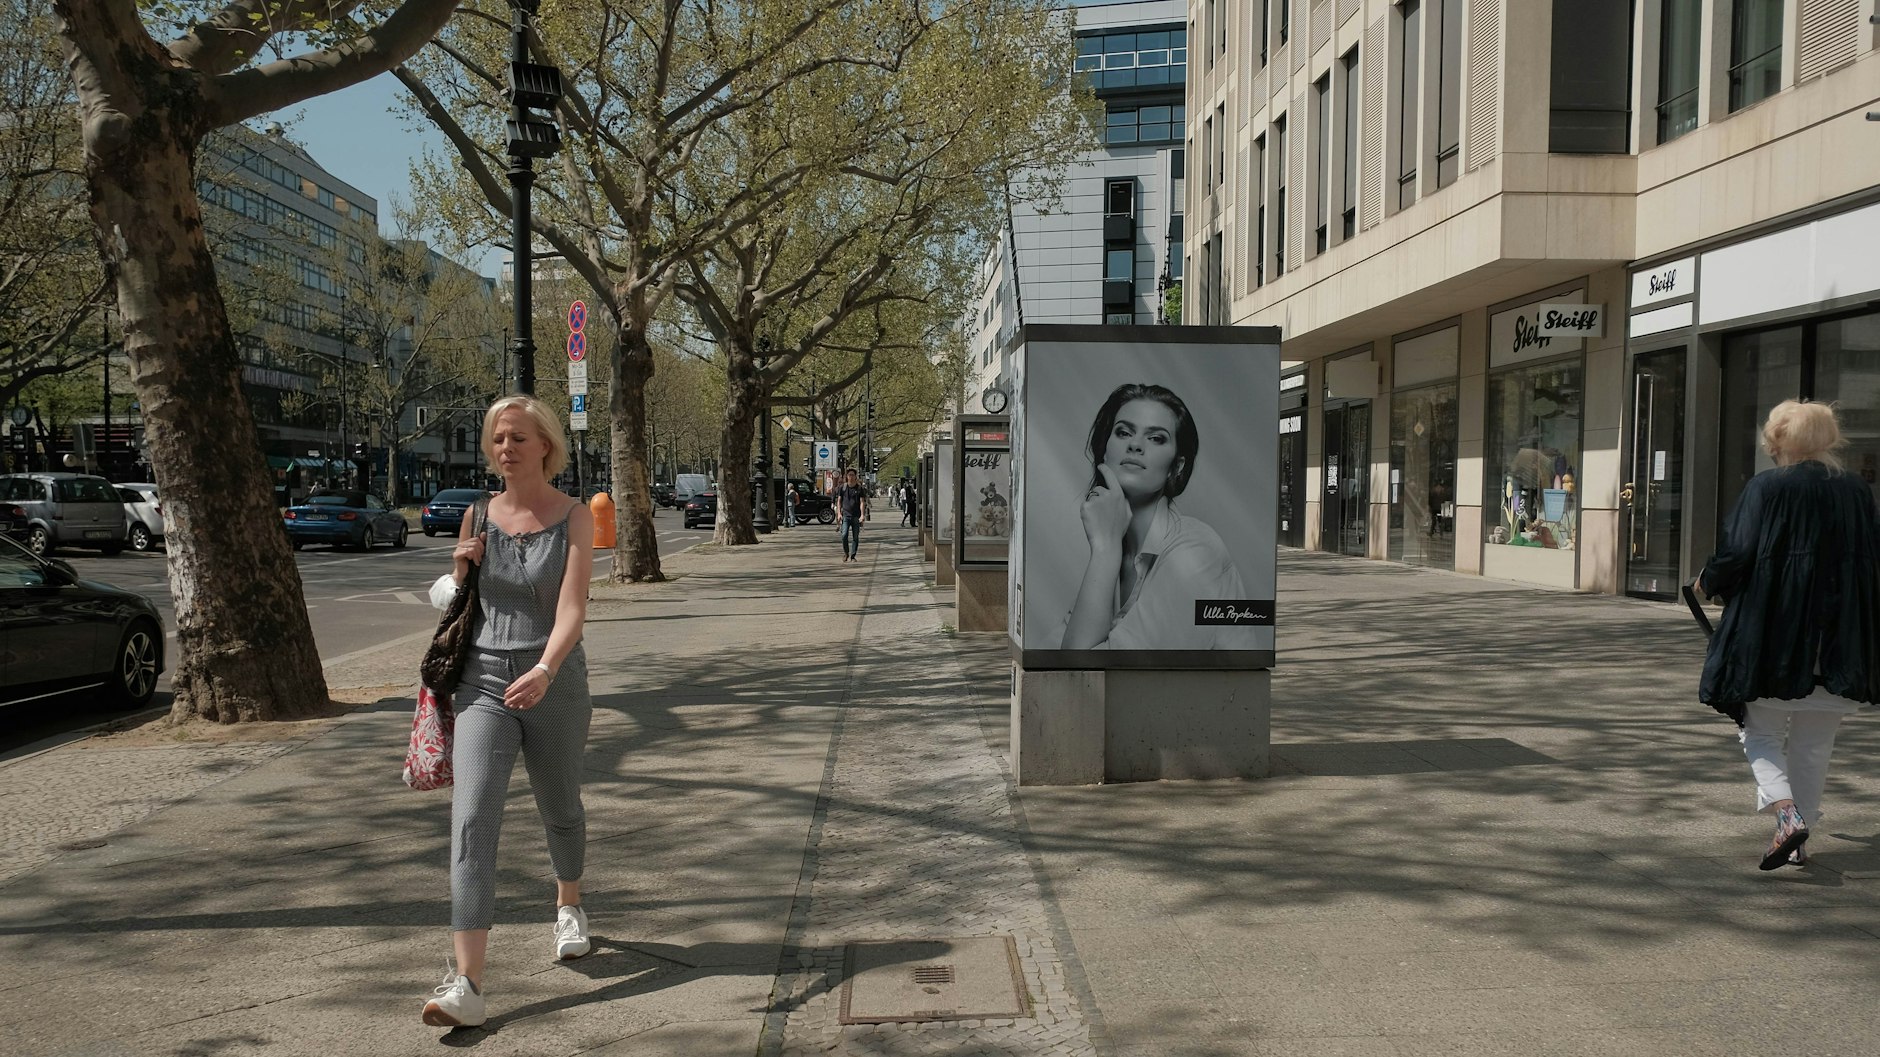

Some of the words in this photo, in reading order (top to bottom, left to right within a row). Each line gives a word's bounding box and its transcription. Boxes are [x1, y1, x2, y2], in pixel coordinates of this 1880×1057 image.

[1648, 268, 1677, 297] Steiff
[1544, 309, 1598, 331] Steiff
[964, 452, 1002, 471] teiff
[1203, 604, 1225, 619] Ulla
[1225, 604, 1267, 623] Popken
